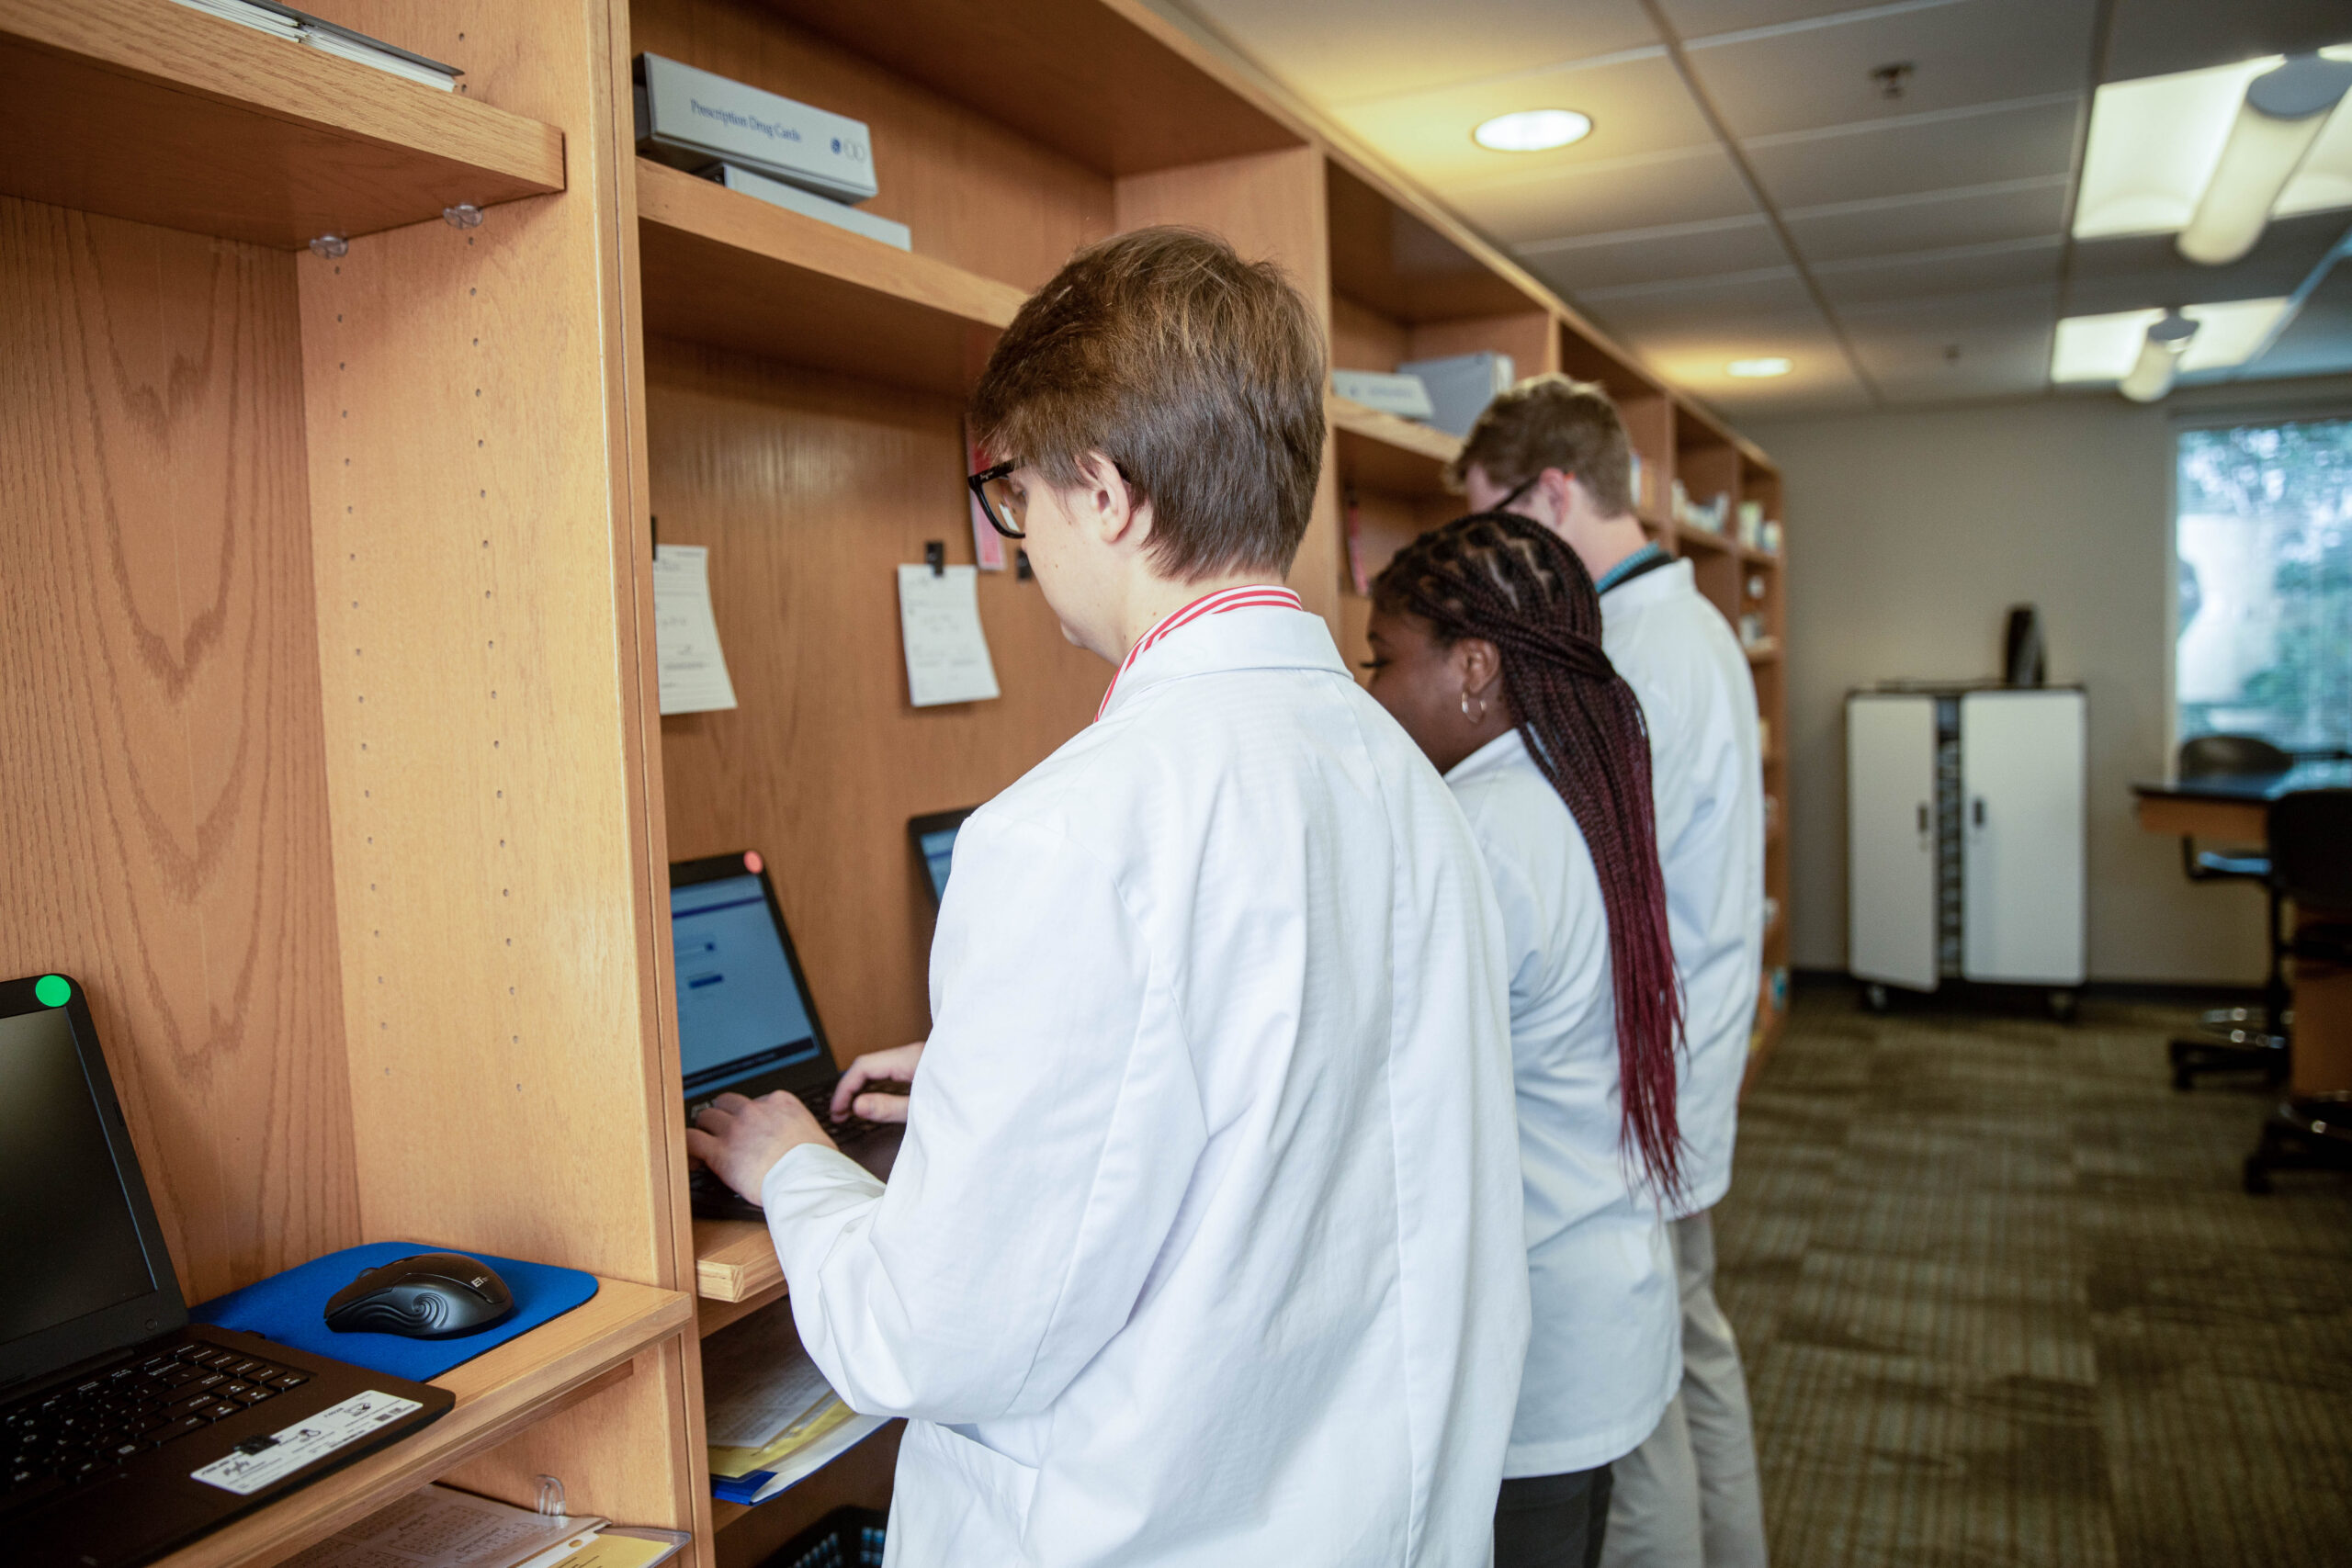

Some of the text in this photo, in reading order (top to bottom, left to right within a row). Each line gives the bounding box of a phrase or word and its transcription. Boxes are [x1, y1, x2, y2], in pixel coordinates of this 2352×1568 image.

[690, 98, 801, 141] Prescription Drug Cards
